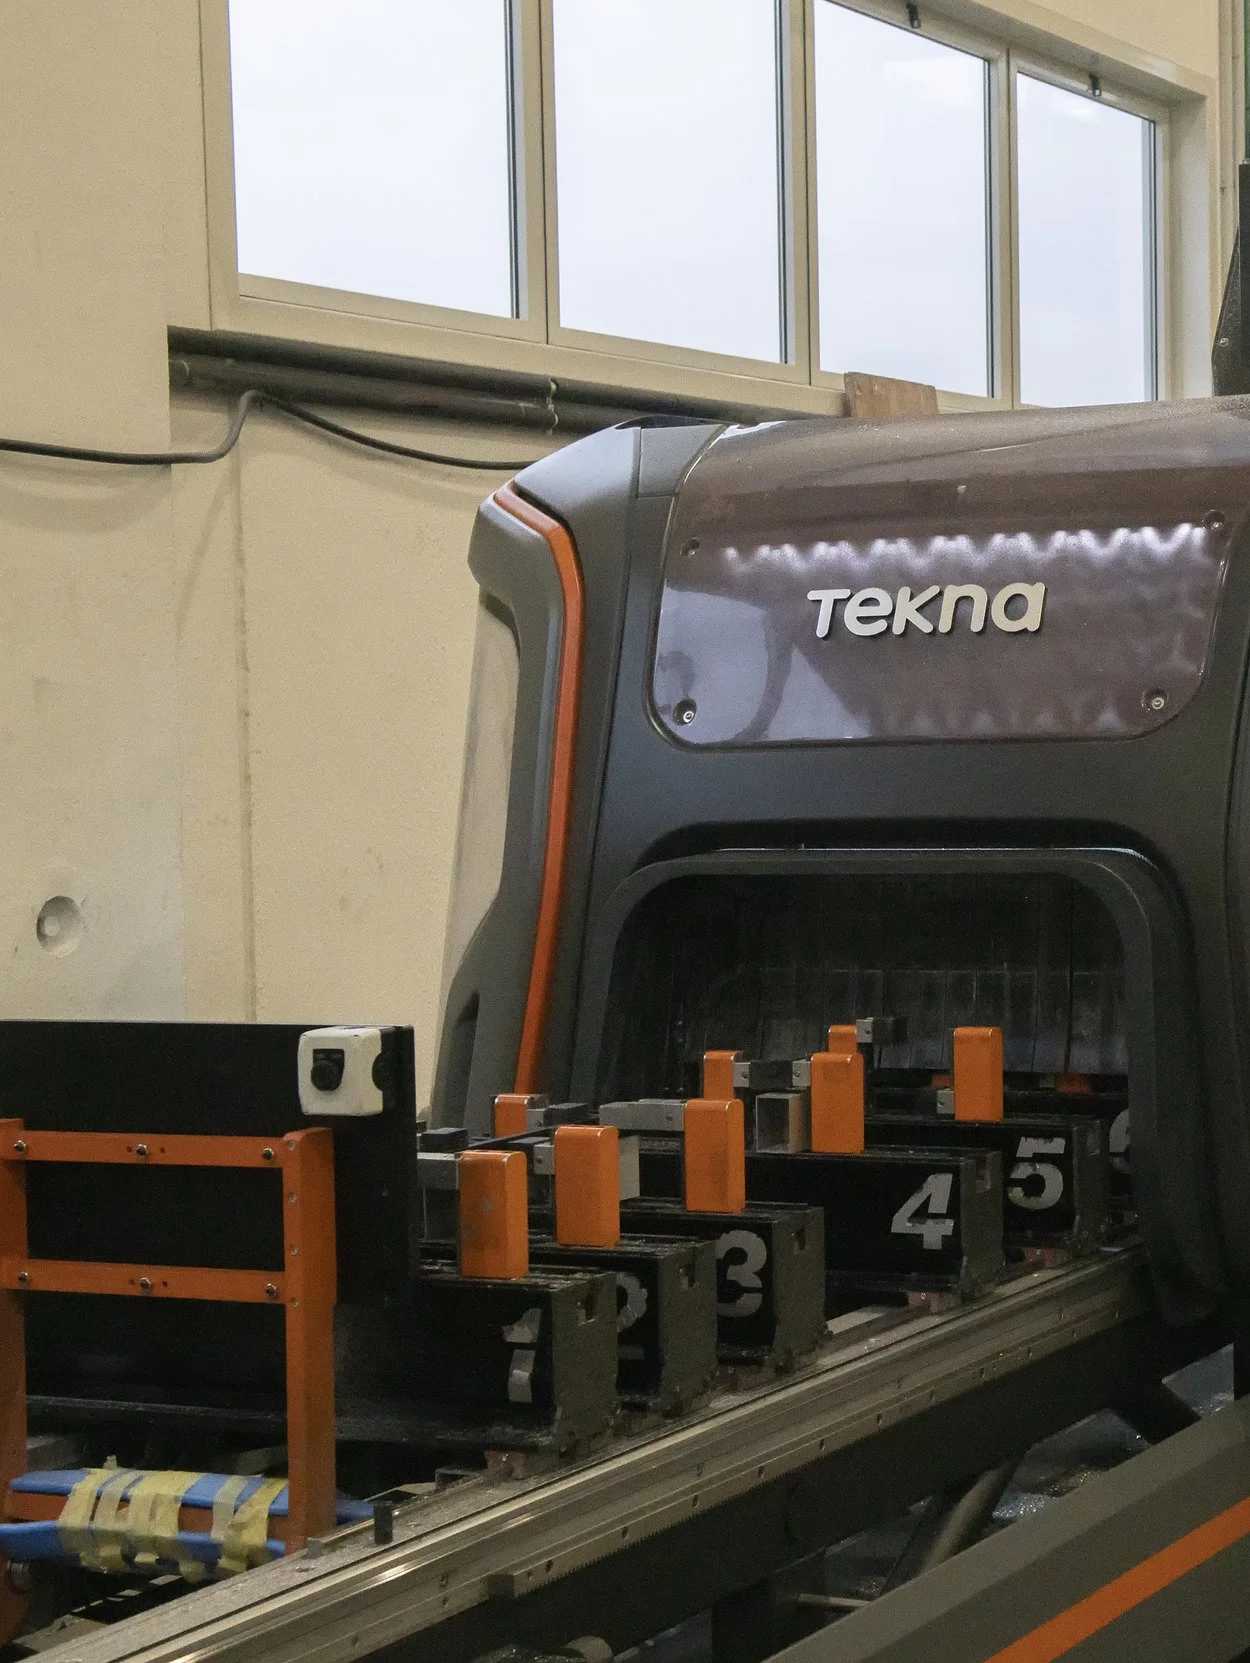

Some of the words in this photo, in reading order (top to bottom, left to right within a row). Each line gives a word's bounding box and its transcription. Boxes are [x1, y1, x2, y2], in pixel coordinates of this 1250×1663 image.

[891, 1173, 954, 1249] 4
[1007, 1136, 1066, 1210] 5
[716, 1230, 767, 1317] 3
[502, 1308, 542, 1403] 1
